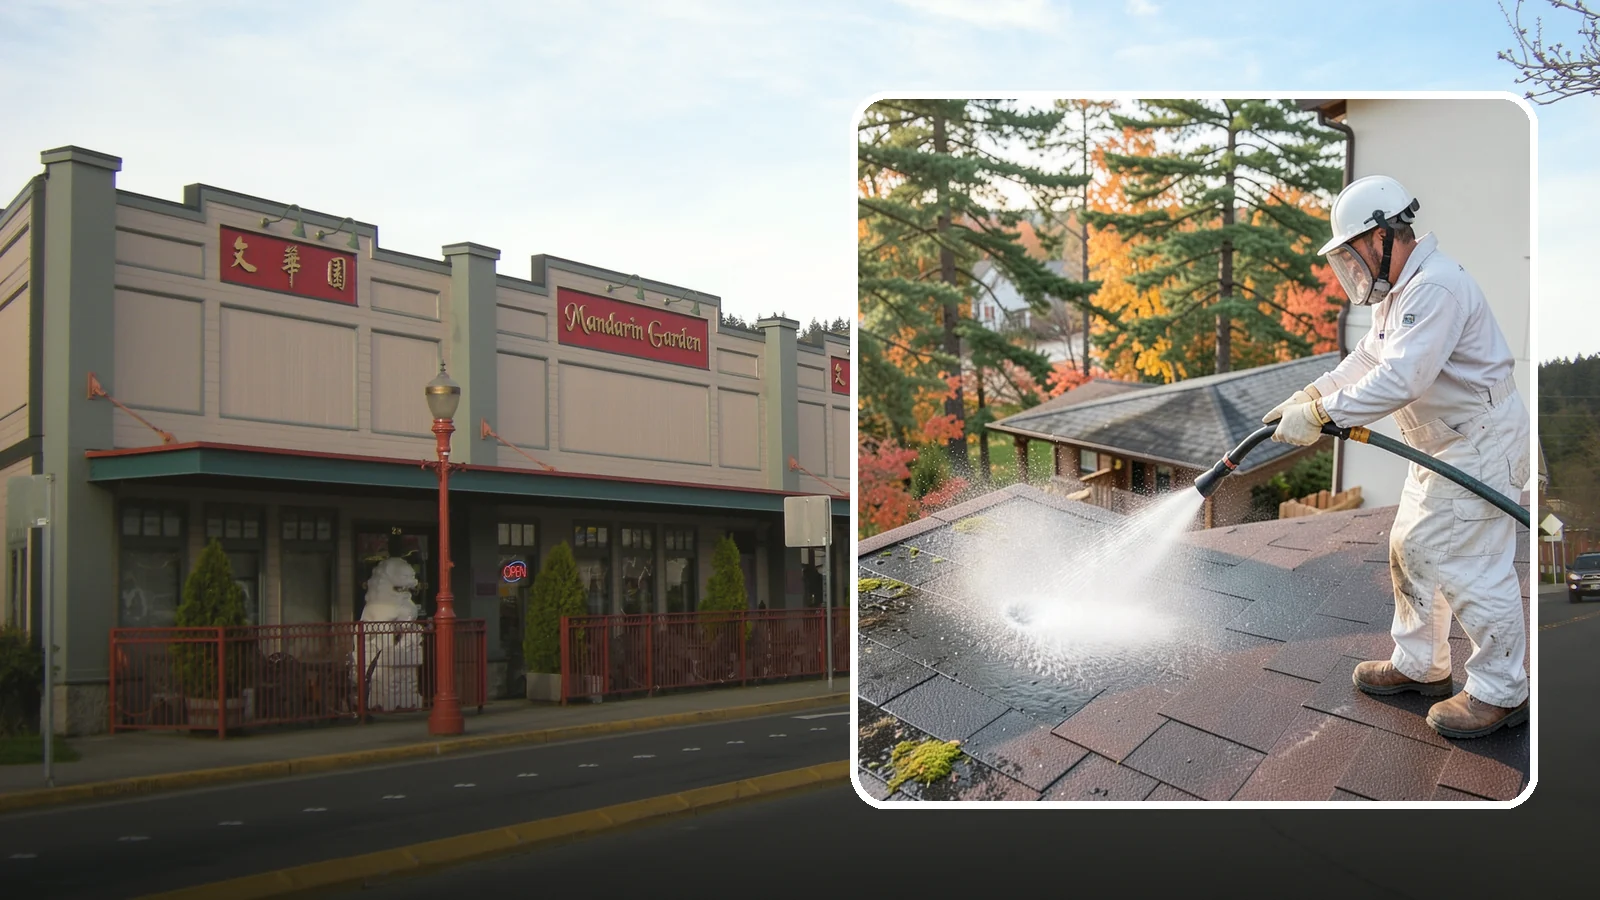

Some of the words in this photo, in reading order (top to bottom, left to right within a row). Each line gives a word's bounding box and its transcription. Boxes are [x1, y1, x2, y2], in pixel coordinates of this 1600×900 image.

[231, 235, 346, 291] 文華園
[564, 302, 644, 341] Mandarin
[647, 320, 701, 352] Garden
[503, 565, 527, 578] OPEN
